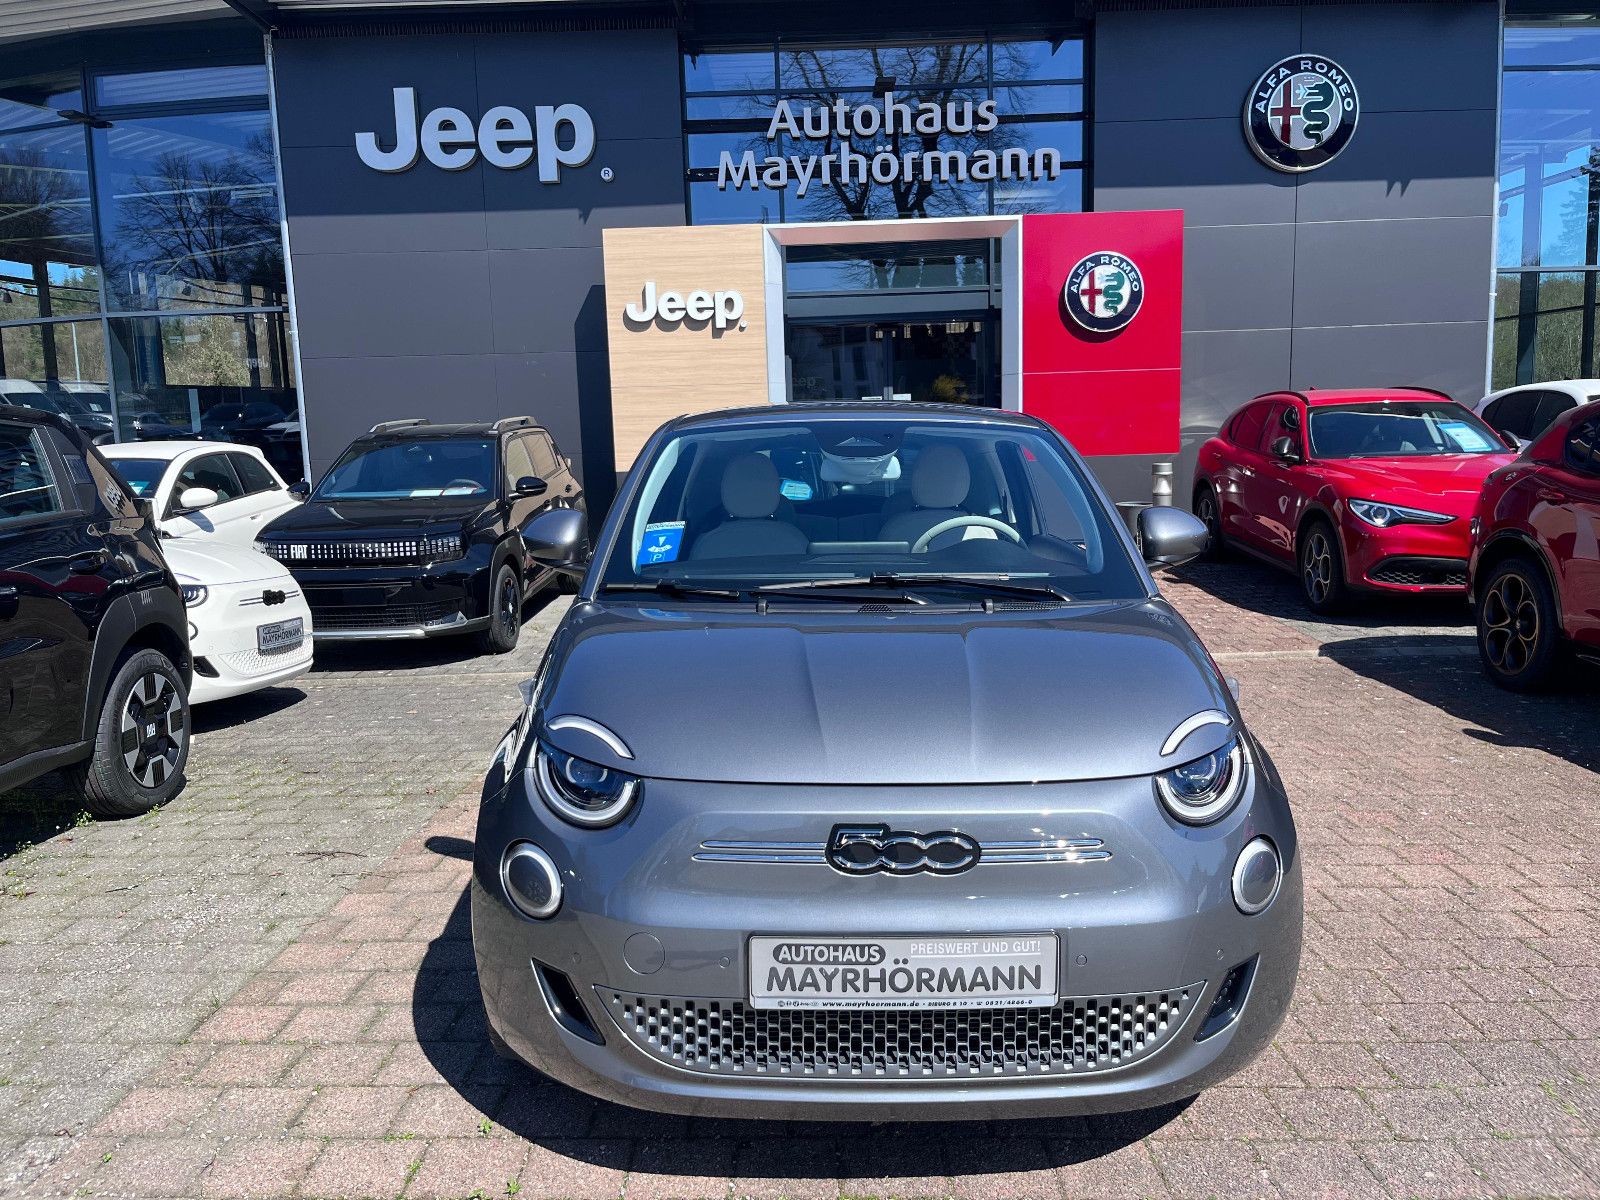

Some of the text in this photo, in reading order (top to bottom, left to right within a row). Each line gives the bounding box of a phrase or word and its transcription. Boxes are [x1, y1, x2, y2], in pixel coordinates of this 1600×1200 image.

[1255, 60, 1354, 113] ALFA ROMEO
[767, 91, 1000, 140] Autohaus
[355, 87, 597, 184] Jeep
[717, 141, 1061, 198] Mayrhörmann
[1070, 255, 1140, 293] ALFA ROMEO
[290, 544, 308, 559] FIAT
[826, 823, 981, 877] 500
[778, 945, 881, 962] AUTOHAUS
[910, 940, 1041, 954] PREISWERT UND GUT!
[766, 957, 1041, 994] MAYRHÖRMANN
[822, 1000, 920, 1008] www.mayrhoermann.de
